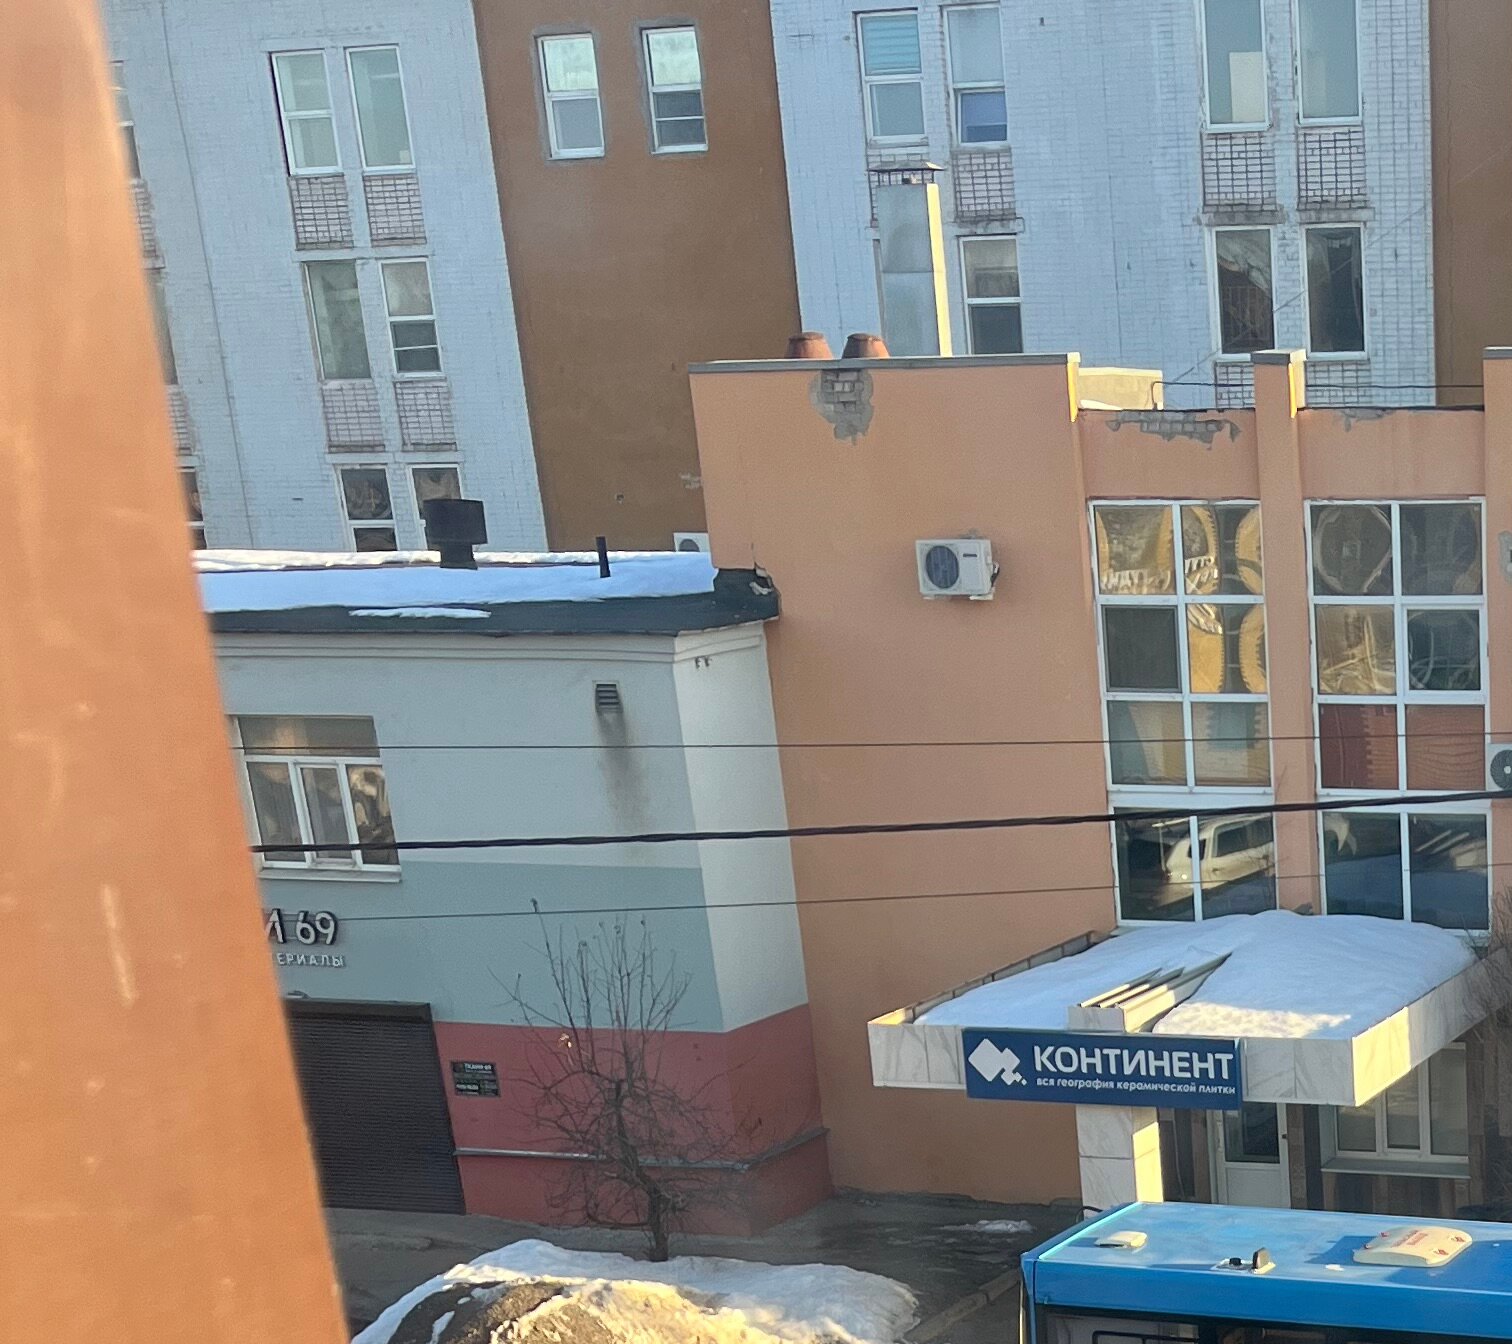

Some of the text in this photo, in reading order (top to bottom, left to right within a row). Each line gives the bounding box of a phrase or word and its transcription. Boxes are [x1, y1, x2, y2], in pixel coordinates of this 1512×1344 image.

[296, 910, 338, 945] 69
[1033, 1045, 1234, 1080] КОНТИНЕНТ
[1036, 1077, 1236, 1095] вся география керамической плитки
